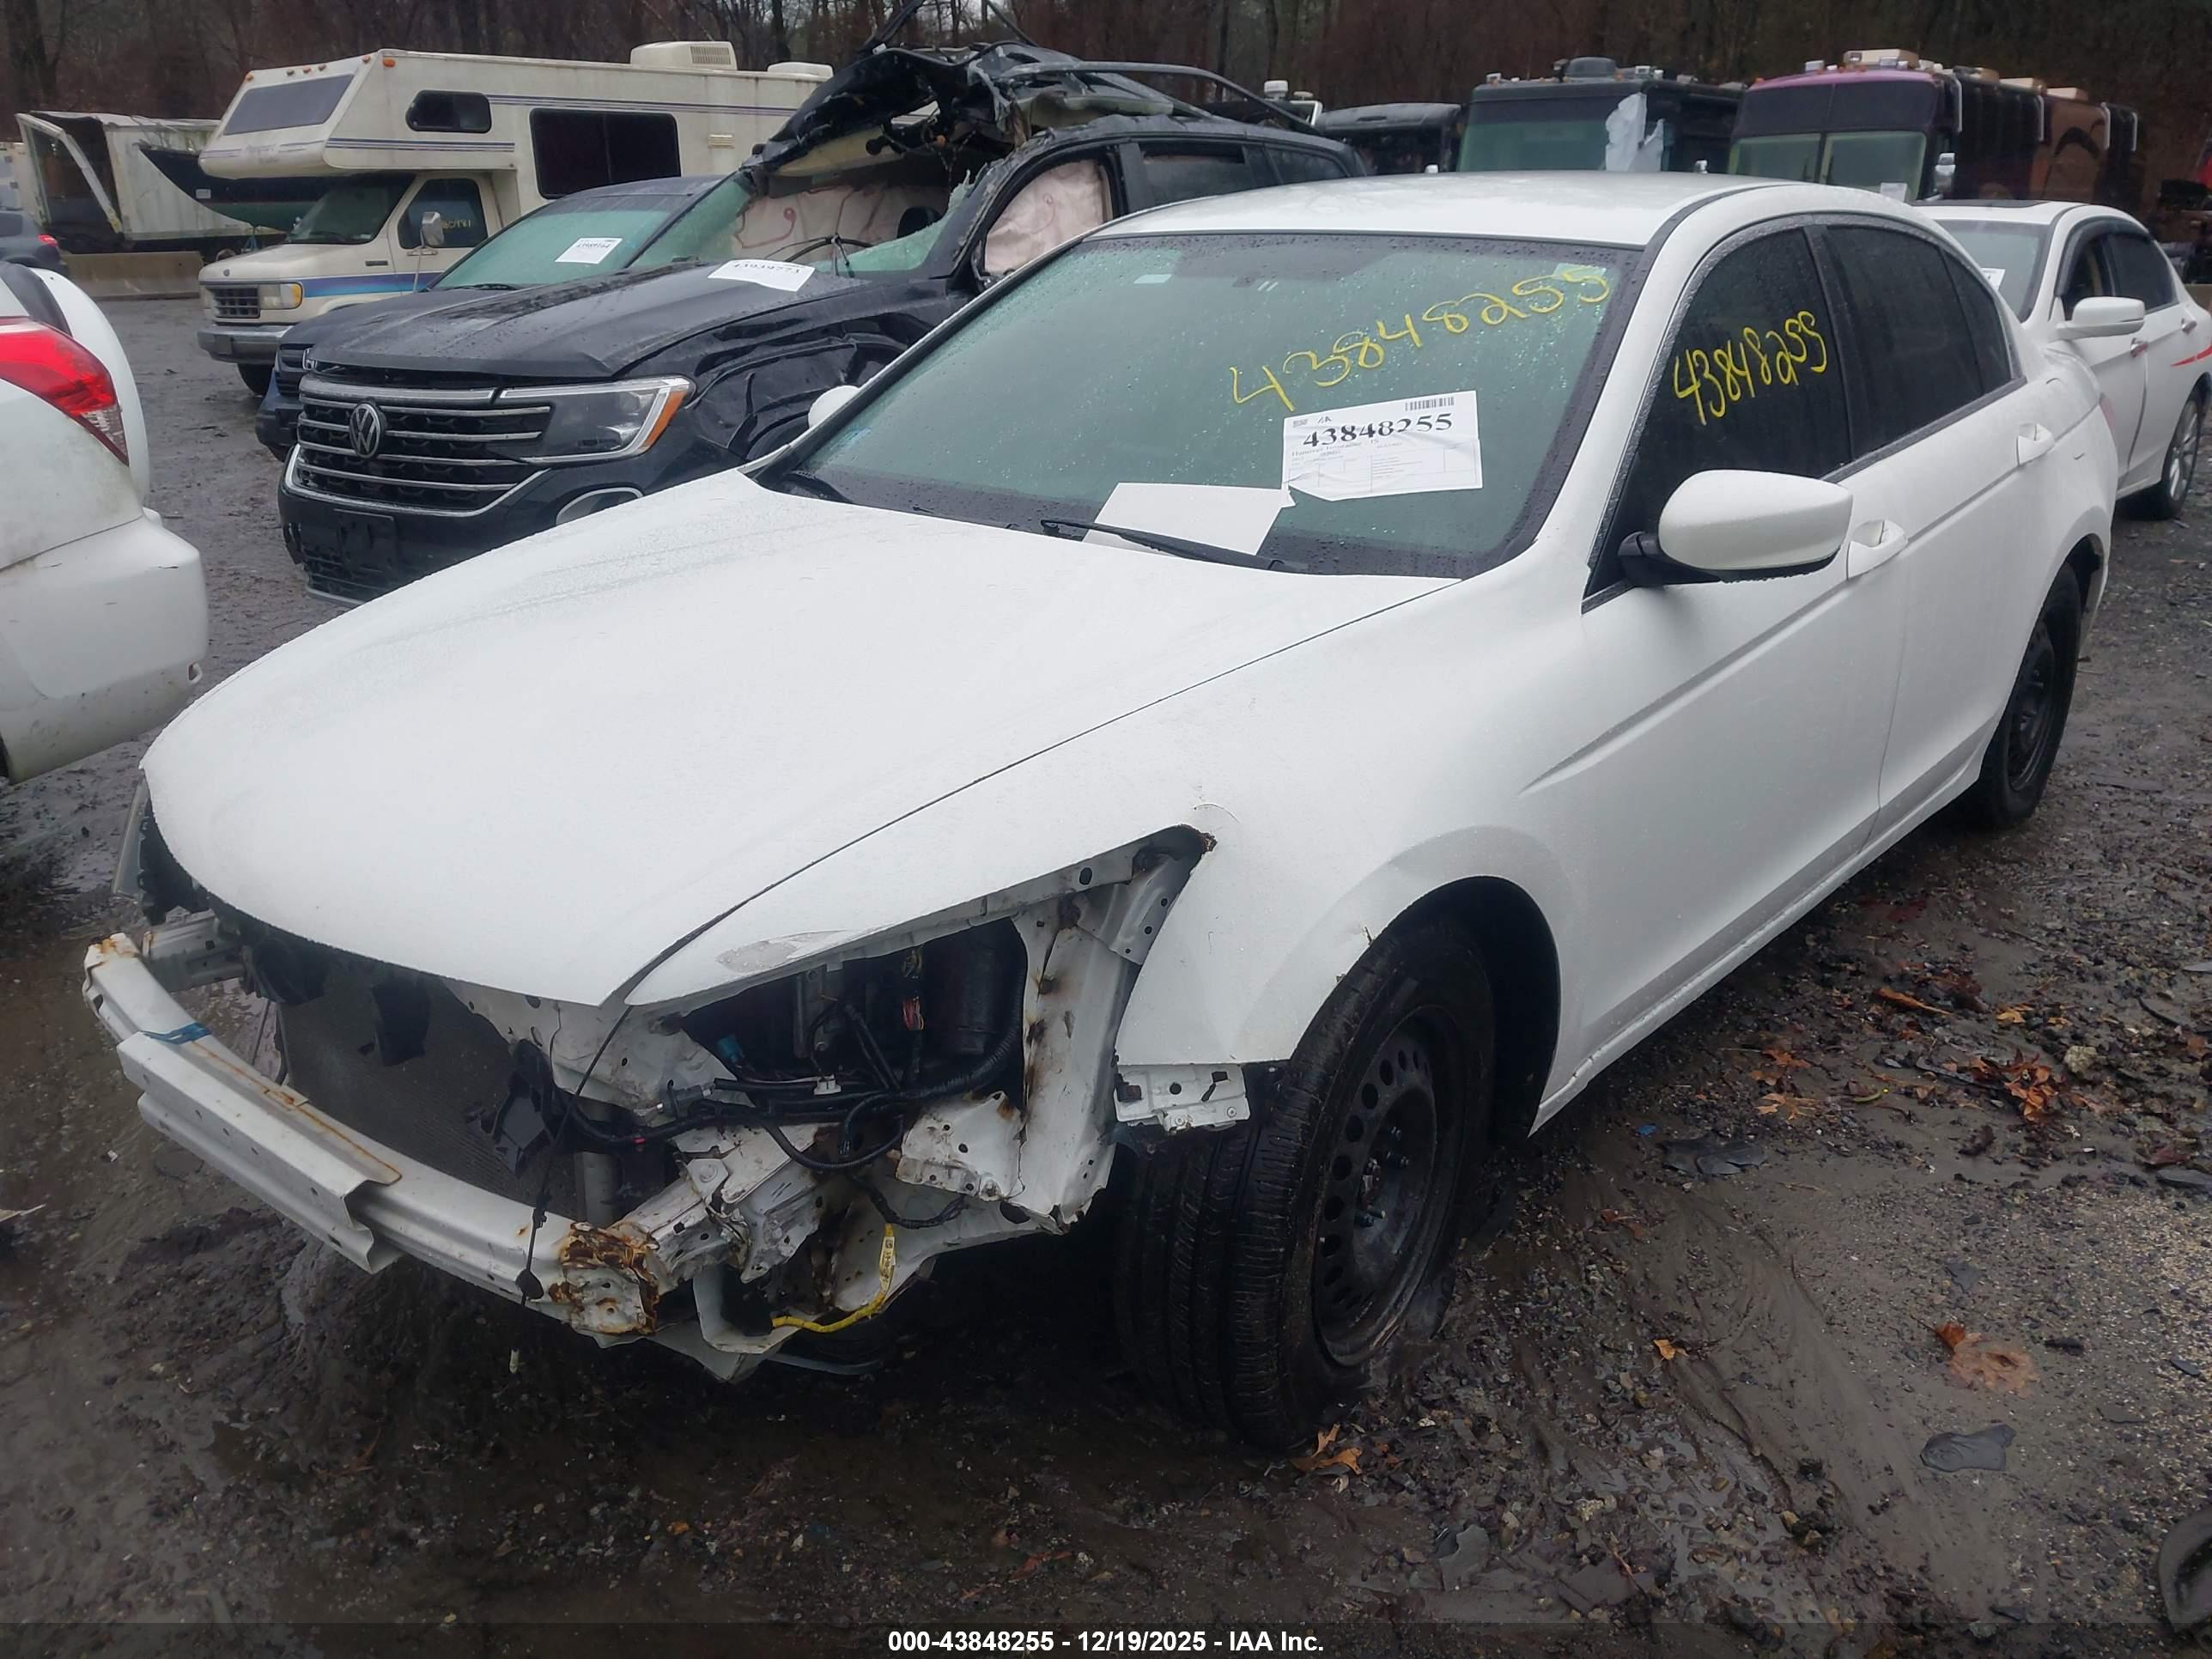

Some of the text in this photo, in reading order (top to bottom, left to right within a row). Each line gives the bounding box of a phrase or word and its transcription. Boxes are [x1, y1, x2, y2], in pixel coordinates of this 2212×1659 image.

[1229, 267, 1609, 411] 43848255
[1674, 310, 1827, 426] 43848255
[1303, 413, 1453, 447] 43848255
